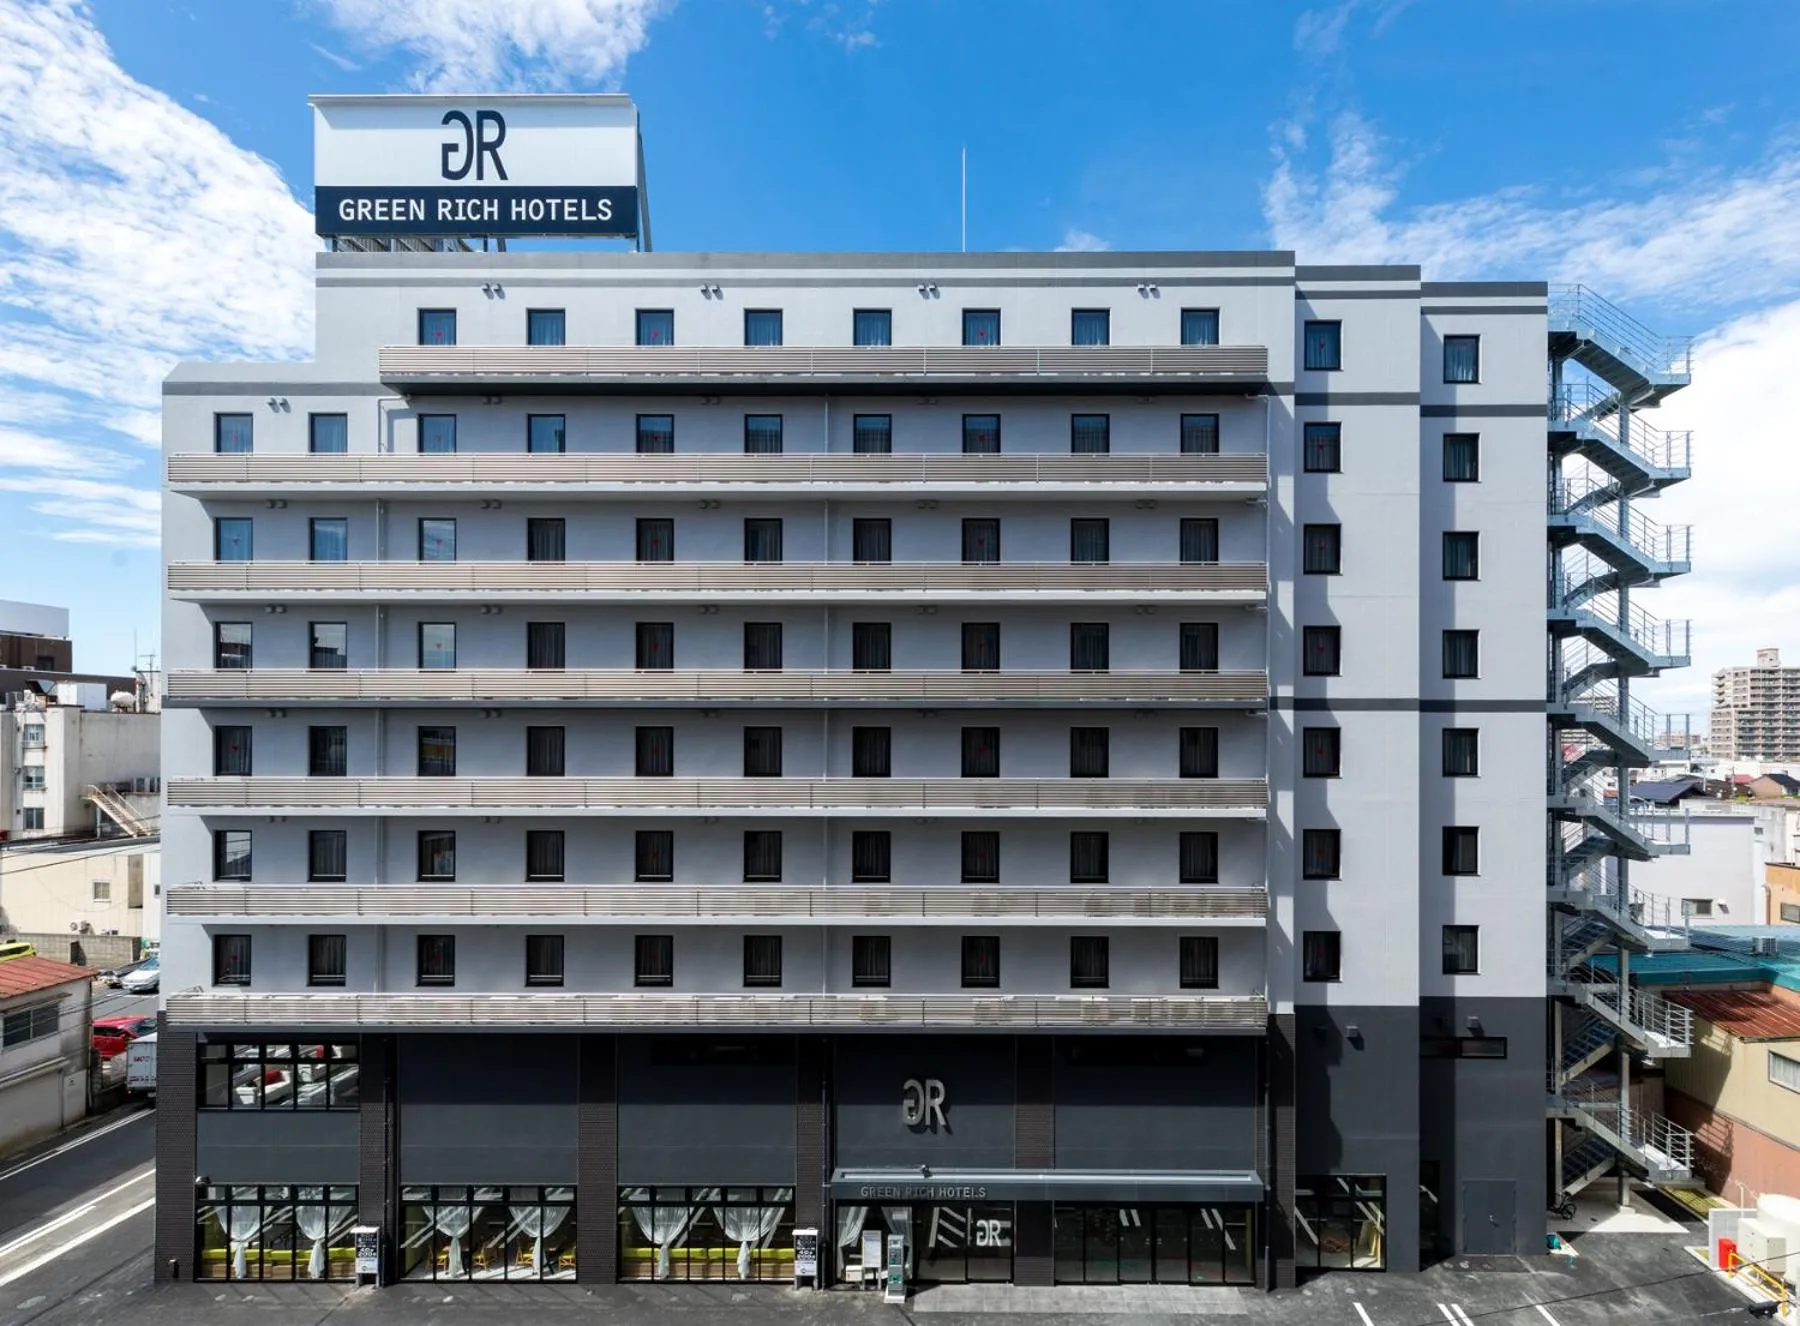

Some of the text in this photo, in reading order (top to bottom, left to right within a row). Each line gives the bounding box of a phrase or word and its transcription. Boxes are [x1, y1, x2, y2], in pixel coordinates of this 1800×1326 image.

[338, 199, 613, 221] GREEN RICH HOTELS
[860, 1186, 987, 1198] GREEN RICH HOTELS
